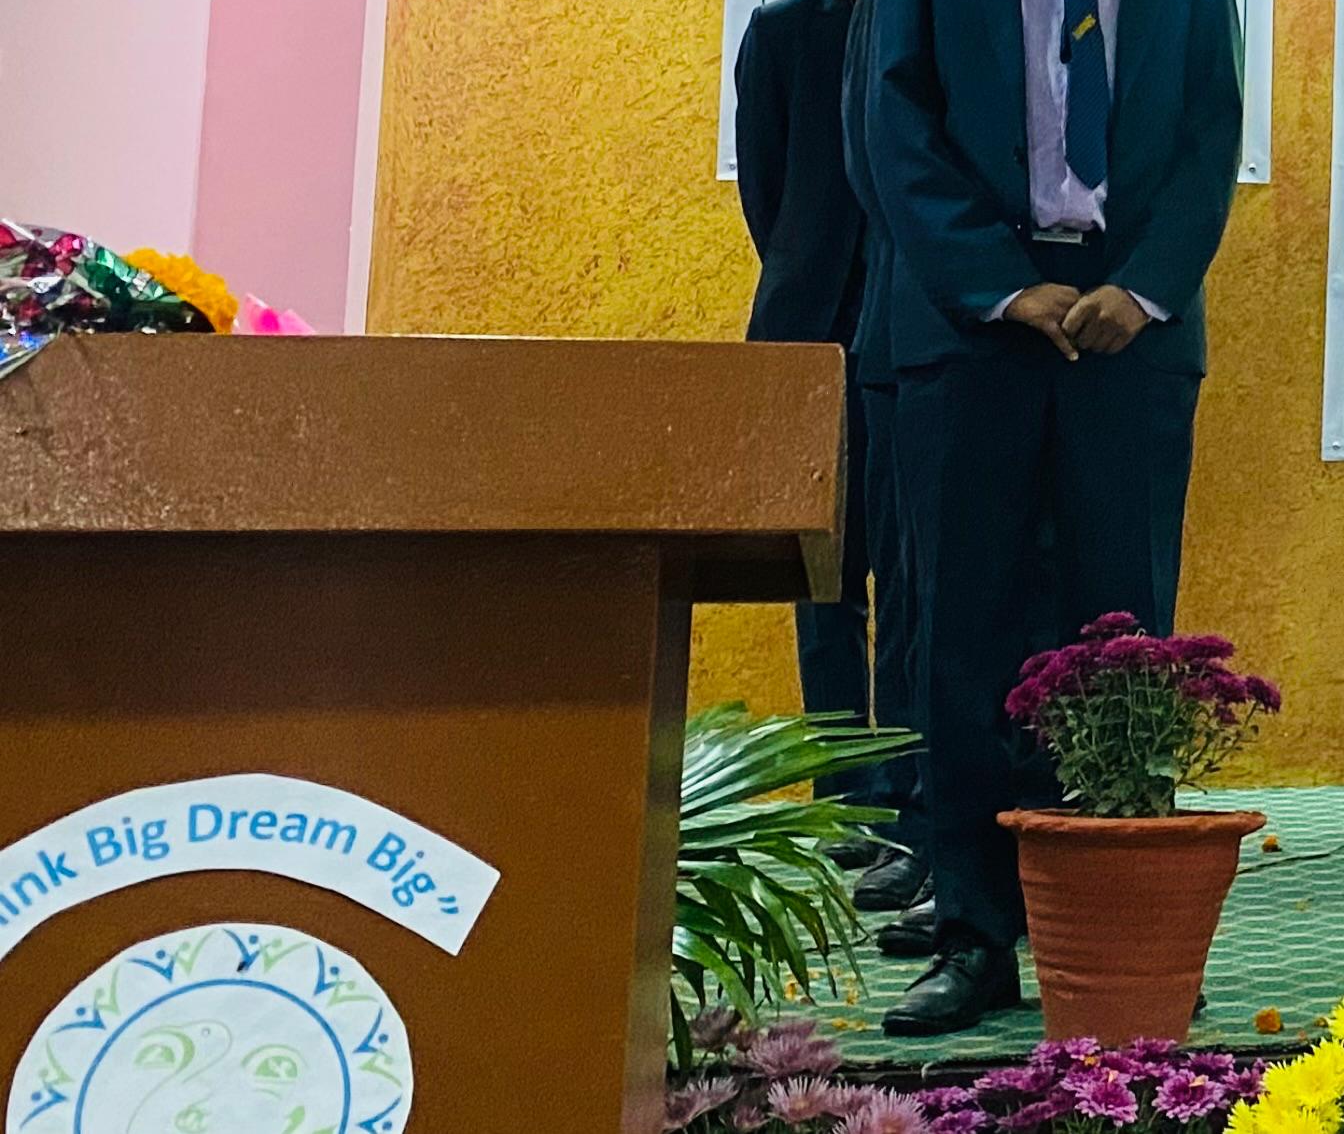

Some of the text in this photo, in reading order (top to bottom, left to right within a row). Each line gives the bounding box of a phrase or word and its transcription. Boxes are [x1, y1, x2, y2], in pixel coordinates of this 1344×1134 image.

[0, 850, 78, 926] ink
[86, 816, 170, 867] Big
[187, 803, 358, 855] Dream
